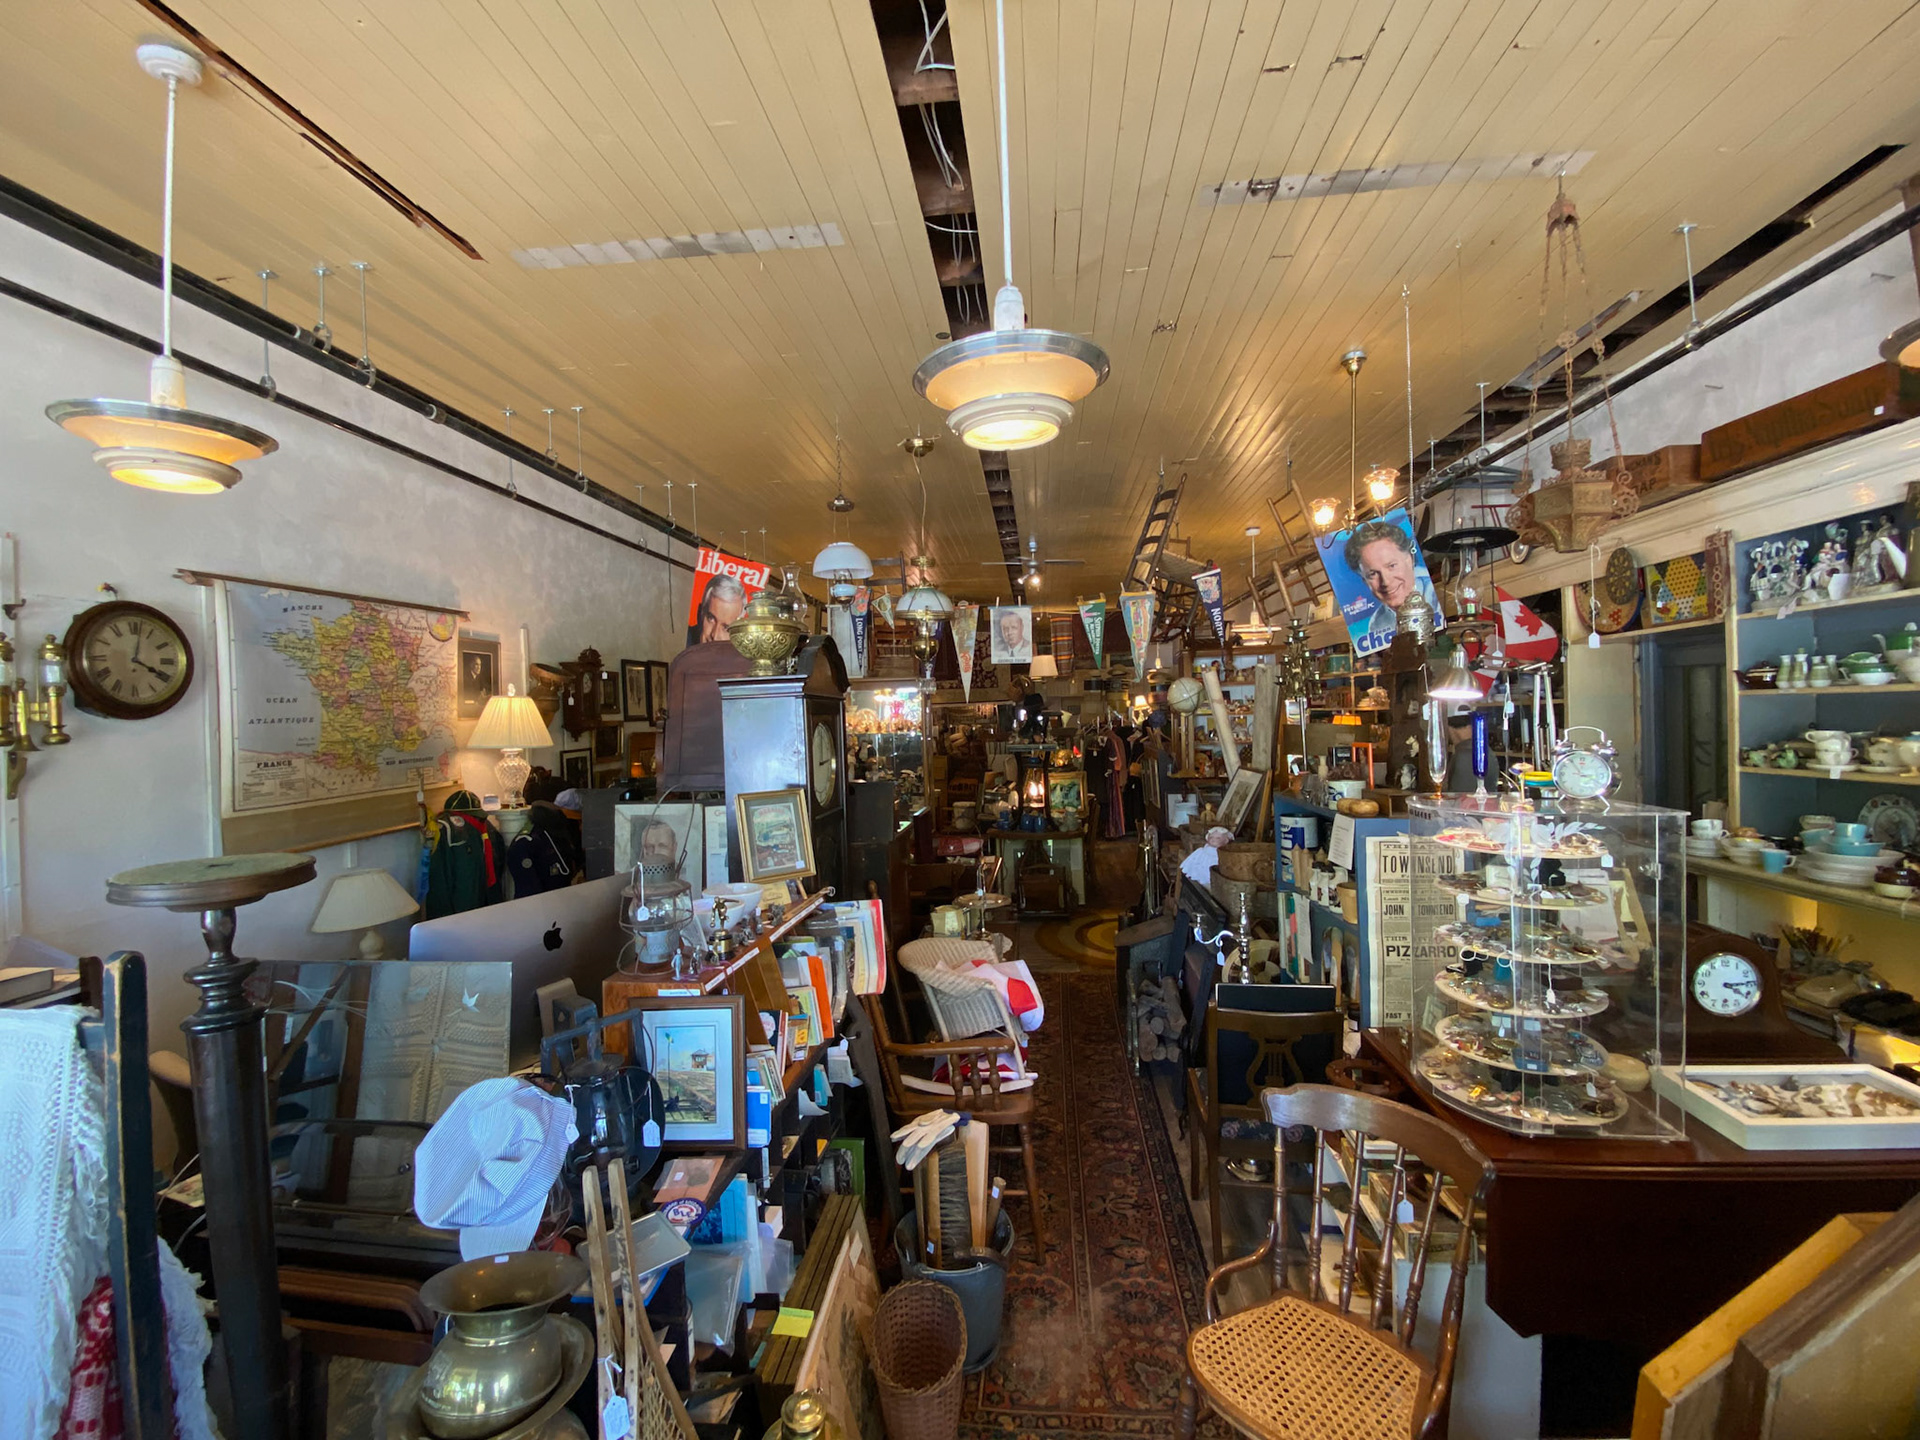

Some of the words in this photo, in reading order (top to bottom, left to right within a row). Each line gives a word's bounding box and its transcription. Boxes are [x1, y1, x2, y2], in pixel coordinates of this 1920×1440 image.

[695, 550, 771, 589] Liberal
[855, 617, 864, 636] LONG
[1211, 607, 1224, 637] NORTH
[248, 716, 315, 725] ATLANTIQUE
[256, 760, 293, 769] FRANCE
[1383, 904, 1405, 915] JOHN
